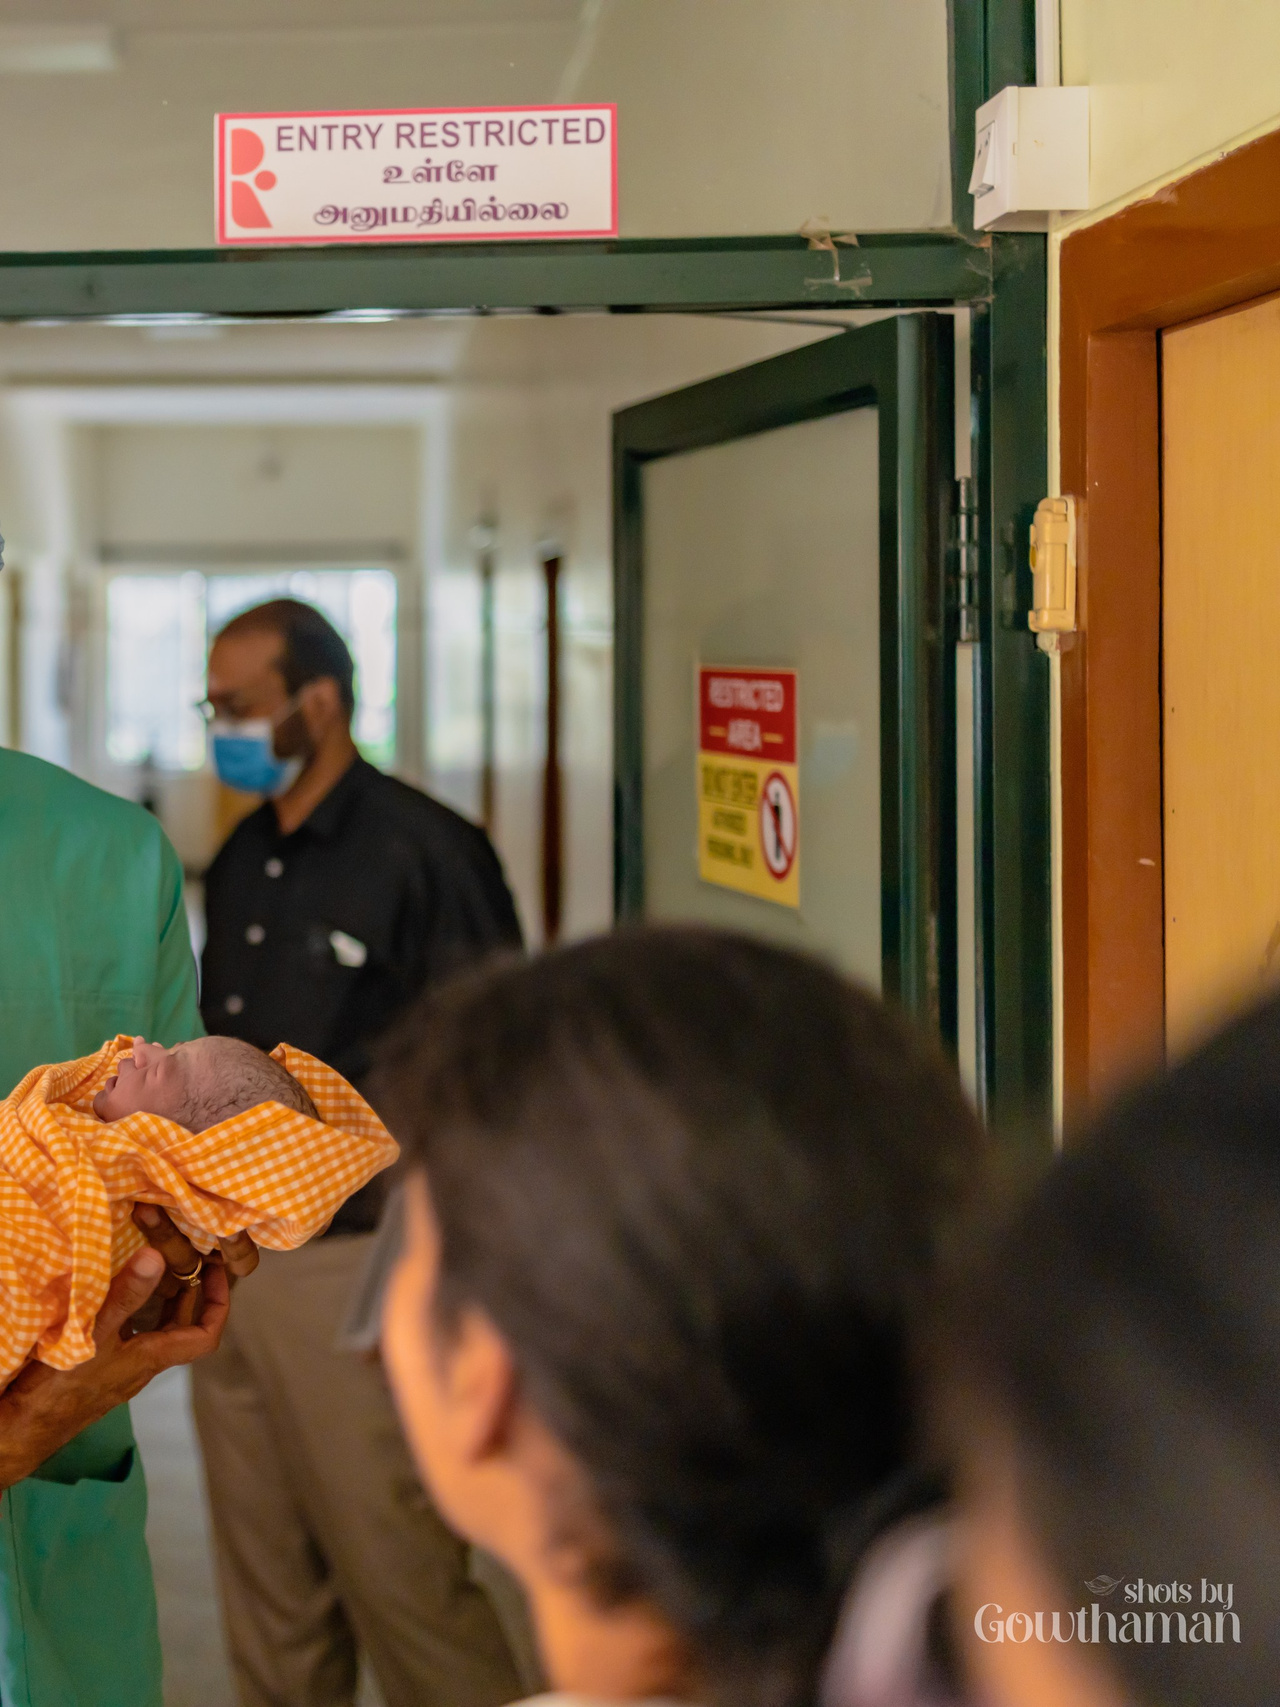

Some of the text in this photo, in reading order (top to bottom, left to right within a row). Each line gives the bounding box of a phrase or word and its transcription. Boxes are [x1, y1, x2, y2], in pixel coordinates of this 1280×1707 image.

[275, 117, 607, 153] ENTRY RESTRICTED
[382, 158, 499, 185] உள்ளே
[313, 196, 570, 232] அனுமதியில்லை
